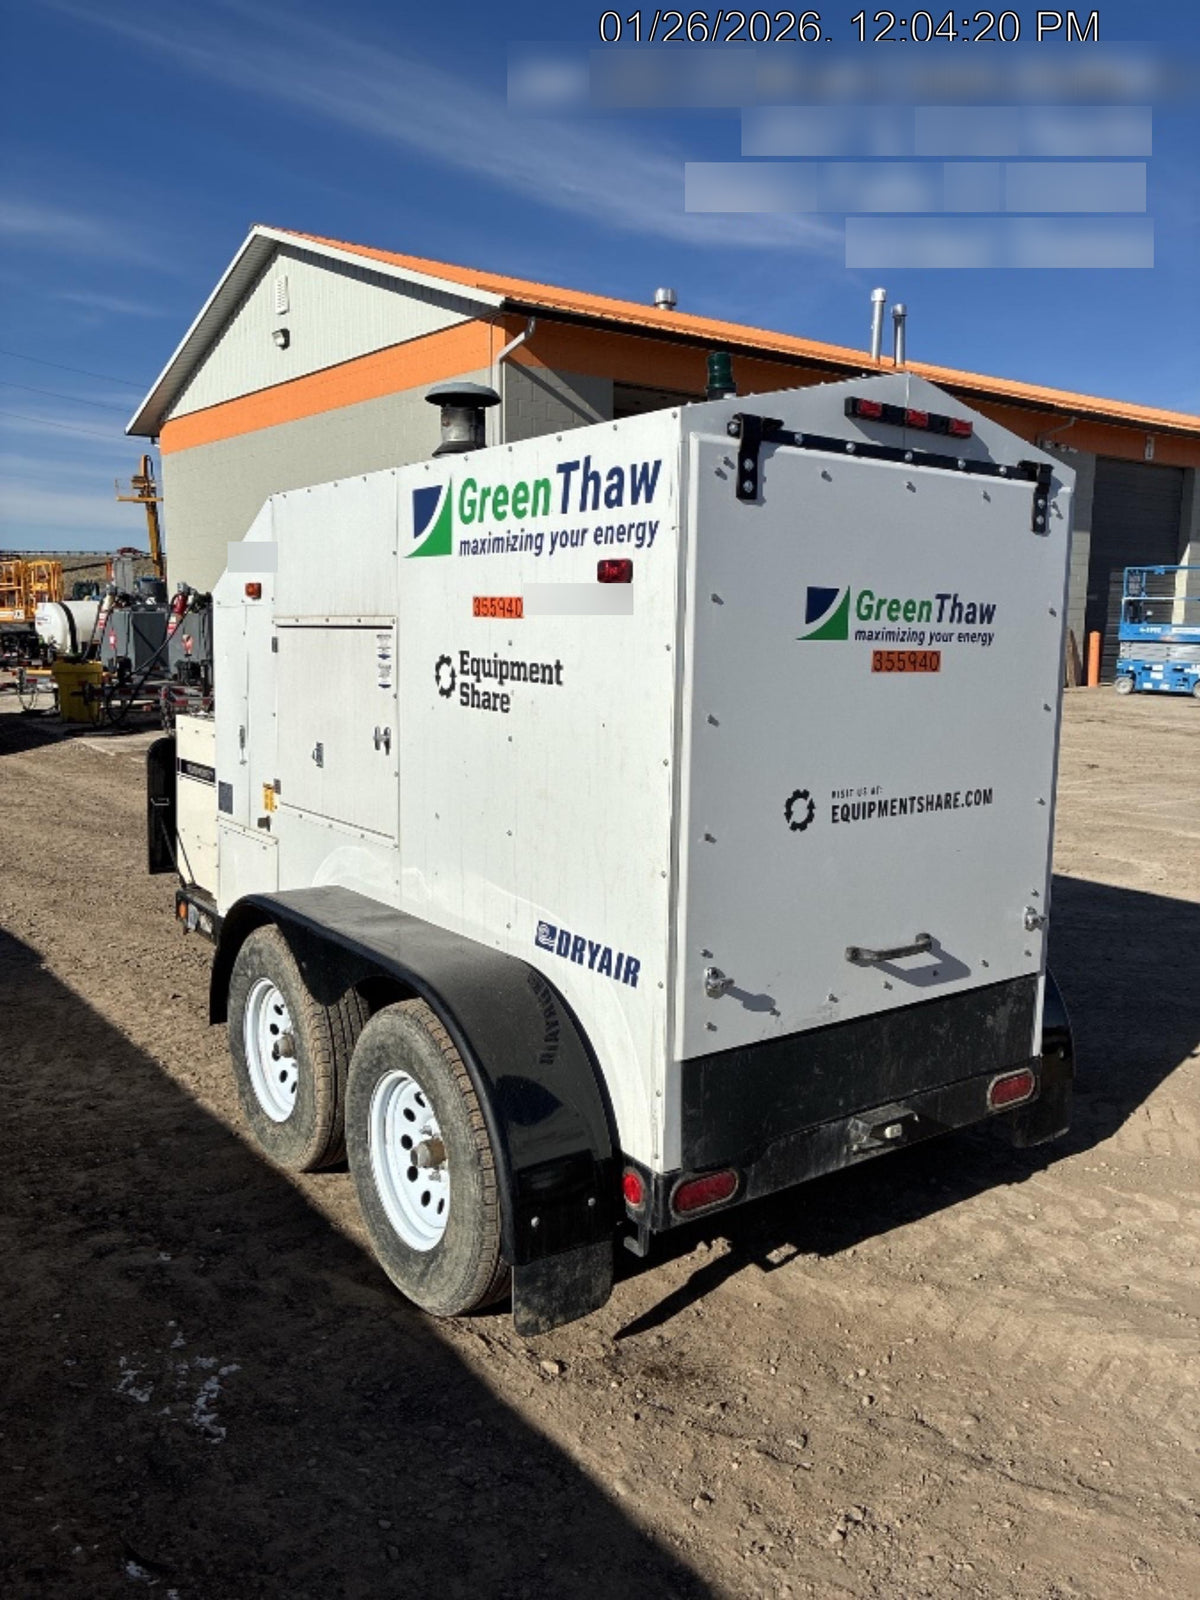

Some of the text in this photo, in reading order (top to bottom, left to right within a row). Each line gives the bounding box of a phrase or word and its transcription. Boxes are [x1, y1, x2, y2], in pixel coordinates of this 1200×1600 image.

[458, 455, 662, 525] GreenThaw
[459, 520, 660, 557] maximizing your energy
[473, 597, 524, 618] 355940
[856, 589, 996, 625] GreenThaw
[854, 627, 995, 647] maximizing your energy
[459, 650, 564, 687] Equipment
[873, 650, 940, 672] 355940
[459, 682, 511, 713] Share
[831, 788, 993, 824] EQUIPMENTSHARE.COM
[556, 929, 641, 989] DRYAIR
